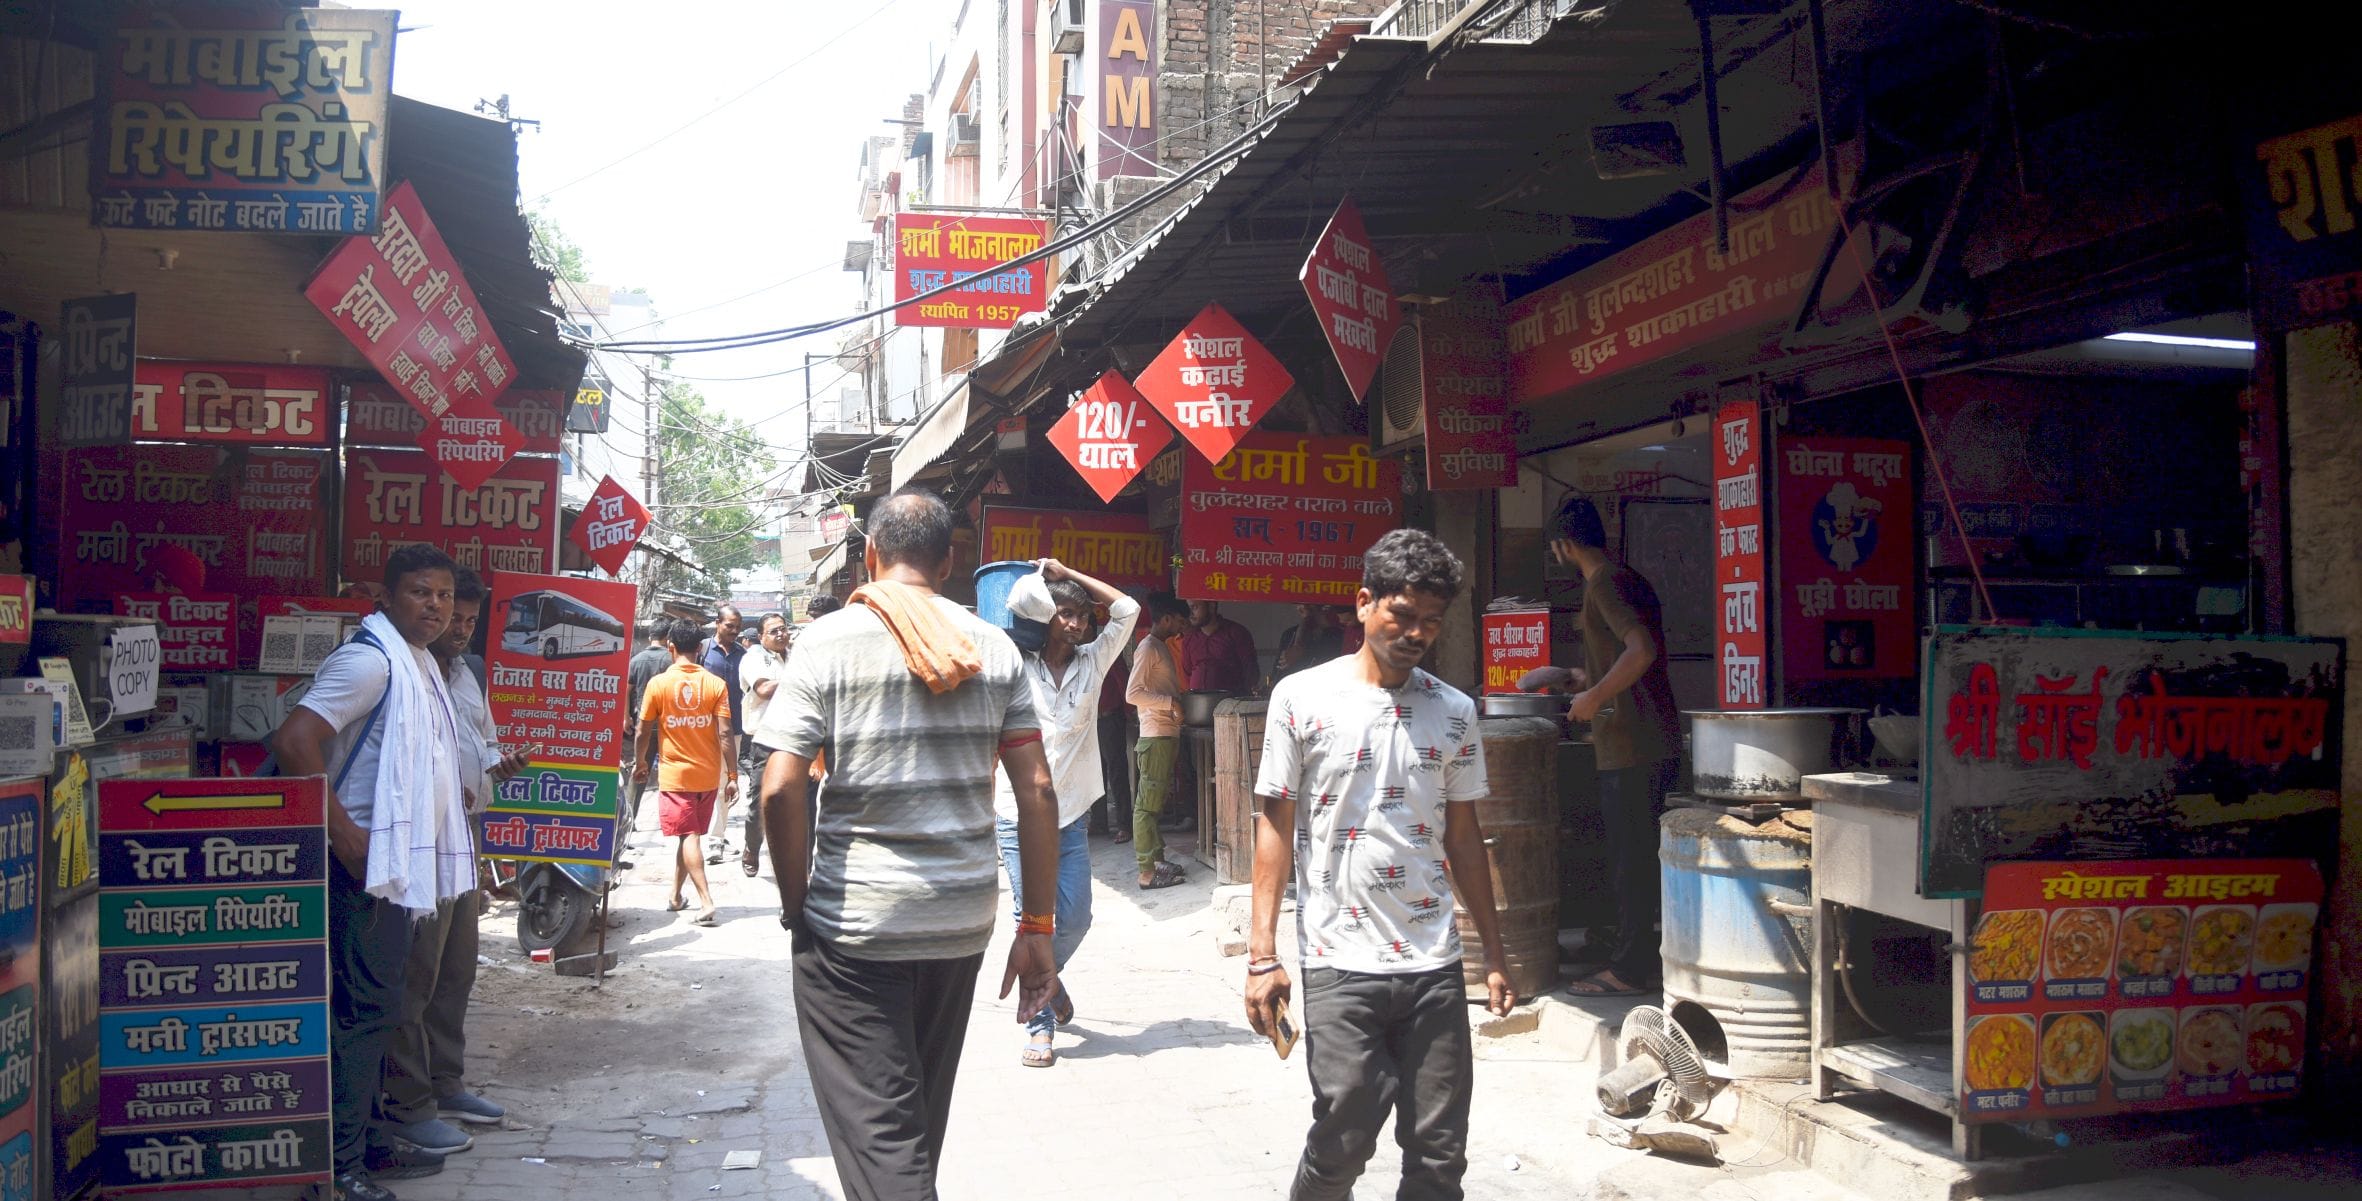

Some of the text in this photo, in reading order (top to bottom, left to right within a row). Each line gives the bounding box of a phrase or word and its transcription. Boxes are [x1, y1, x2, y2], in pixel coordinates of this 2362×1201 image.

[117, 13, 376, 96] मोबाईल
[108, 102, 371, 180] रिपेयरिंग
[101, 190, 136, 229] कटे
[143, 190, 178, 230] फटे
[187, 191, 229, 229] नोट
[235, 193, 287, 231] बदले
[298, 194, 345, 232] जाते
[900, 220, 942, 258] शर्मा
[919, 302, 1020, 321] स्थापित 1957
[1183, 333, 1244, 359] स्पेशल
[179, 372, 319, 435] टिकट
[1174, 393, 1253, 428] पनीर
[440, 413, 503, 438] मोबाइल
[1075, 401, 1146, 440] 120/-
[437, 439, 505, 462] रिपेयरिंग
[1211, 440, 1310, 485] शर्मा
[1323, 443, 1381, 489] जी
[359, 455, 426, 525] रेल
[596, 494, 625, 519] रेल
[586, 518, 637, 551] टिकट
[1296, 519, 1357, 544] 1967
[1288, 549, 1316, 568] शर्मा
[1319, 553, 1337, 569] का
[1282, 576, 1363, 596] भोजनाल
[168, 596, 230, 621] टिकट
[114, 638, 156, 668] PHOTO
[118, 671, 151, 697] COPY
[492, 661, 621, 694] तेजस बस सर्विस
[539, 772, 600, 807] टिकट
[484, 816, 530, 848] मनी
[123, 839, 189, 881] रेल
[201, 836, 300, 878] टिकट
[2041, 870, 2281, 901] स्पेशल आइटम
[123, 900, 208, 937] मोबाइल
[123, 958, 301, 999] प्रिन्ट आउट
[123, 1014, 302, 1056] मनी ट्रांसफर
[136, 1070, 292, 1099] आधार से पैसे
[125, 1097, 213, 1121] निकाले
[220, 1093, 274, 1113] जाते
[125, 1129, 304, 1180] फोटो कापी
